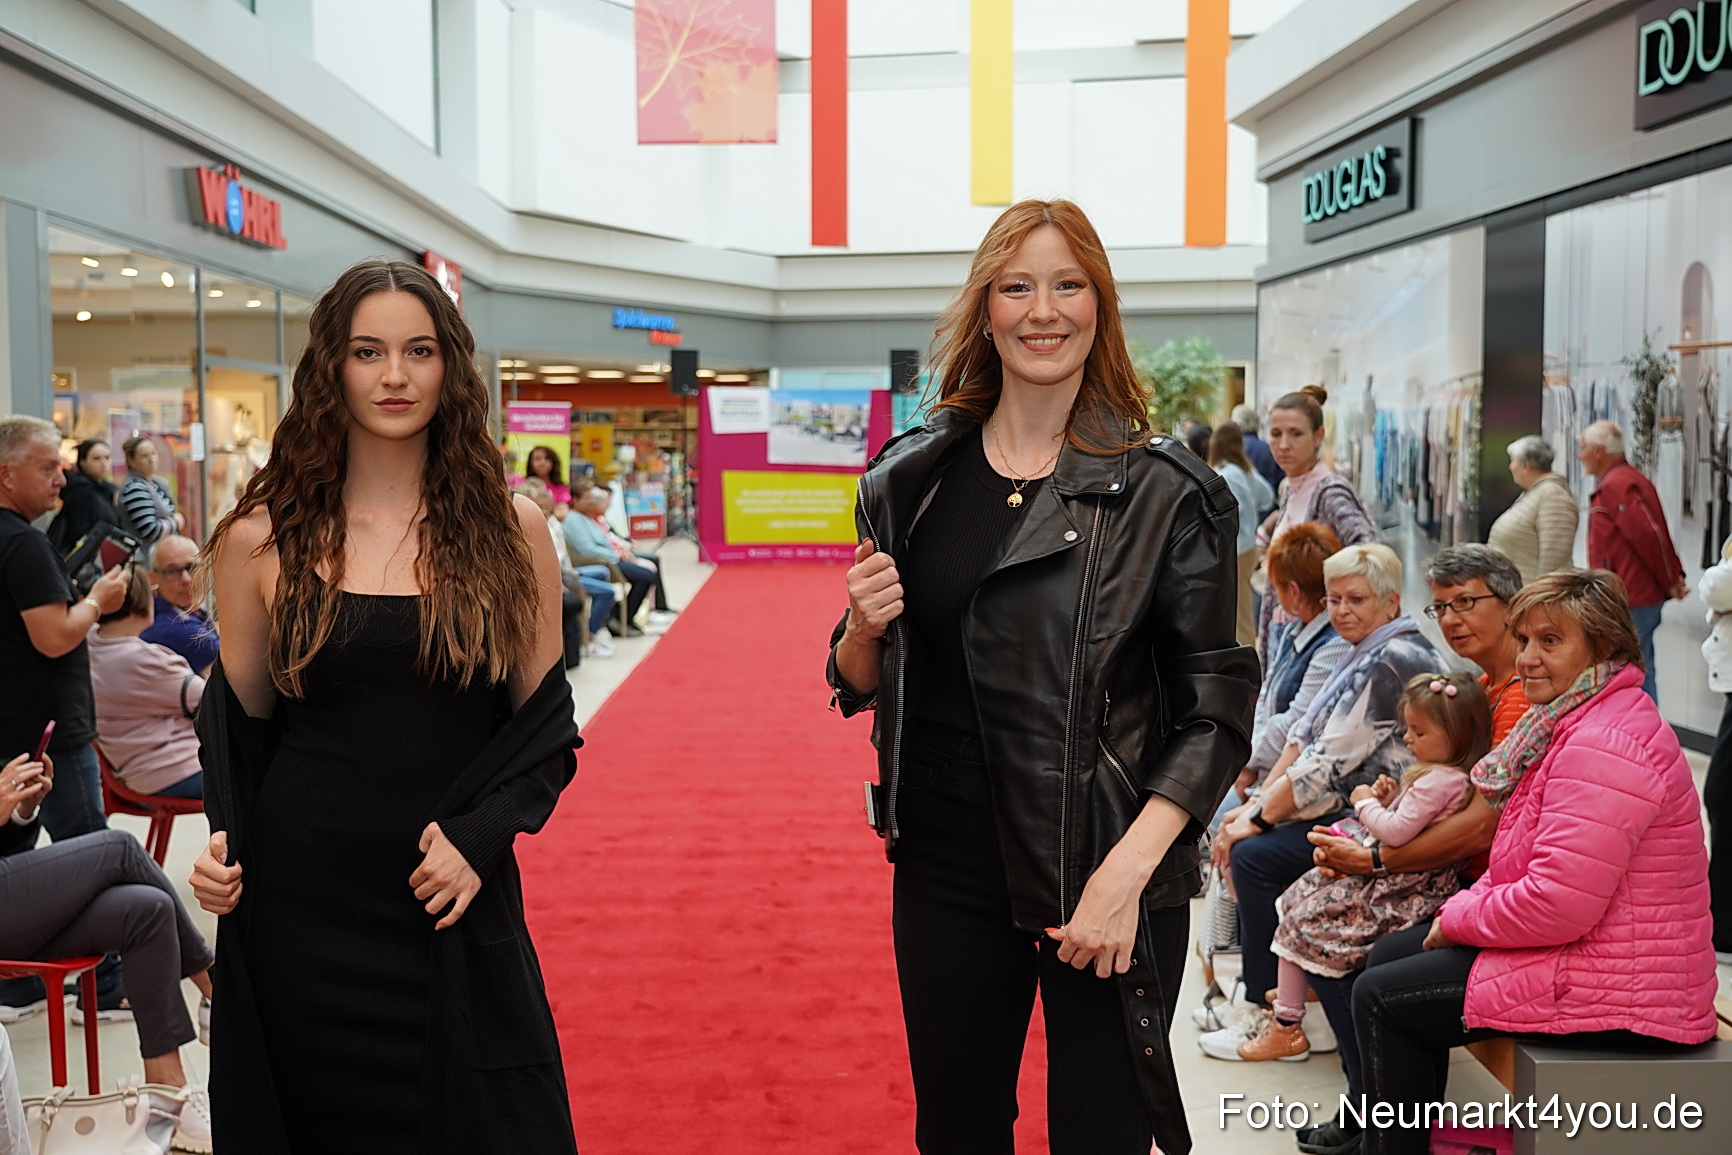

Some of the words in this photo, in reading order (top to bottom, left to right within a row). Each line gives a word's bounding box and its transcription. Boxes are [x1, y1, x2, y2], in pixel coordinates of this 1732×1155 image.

[1638, 0, 1732, 96] DOU
[196, 163, 288, 250] WÖHRL
[1302, 145, 1386, 224] DOUGLAS
